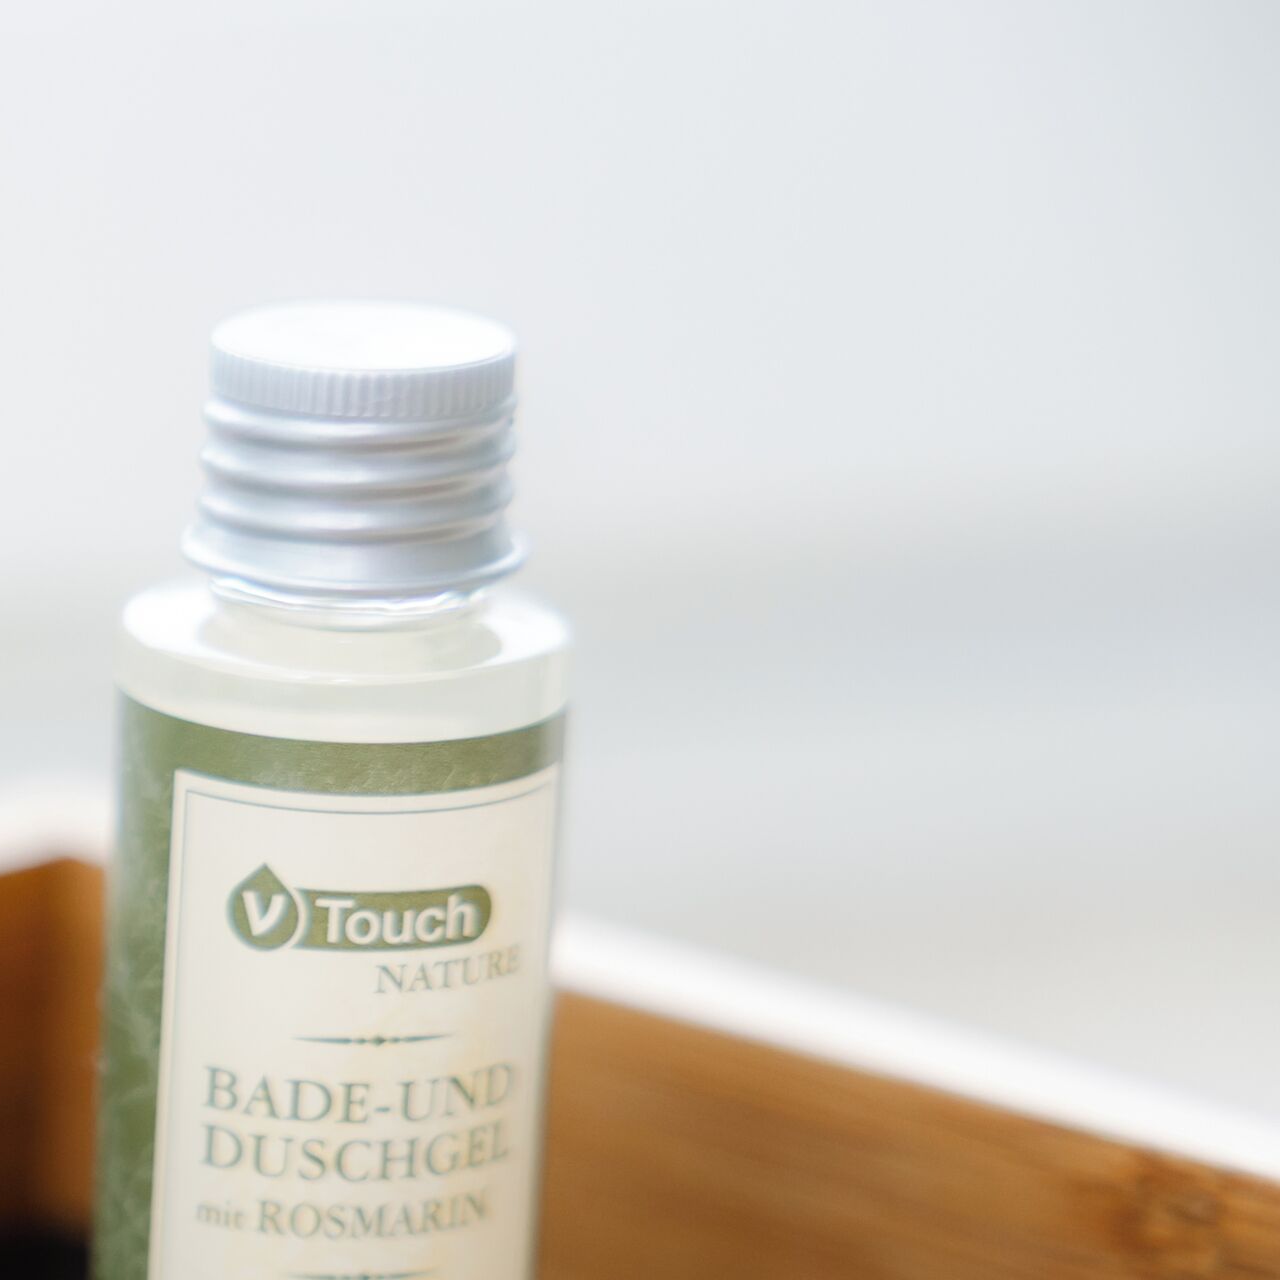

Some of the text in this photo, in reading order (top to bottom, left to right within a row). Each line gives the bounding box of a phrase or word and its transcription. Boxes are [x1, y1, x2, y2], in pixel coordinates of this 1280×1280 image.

[315, 894, 476, 946] Touch
[374, 944, 522, 994] NATURE
[203, 1062, 515, 1124] BADE-UND
[200, 1118, 510, 1183] DUSCHGEL
[196, 1189, 491, 1240] mit ROSMARIN
